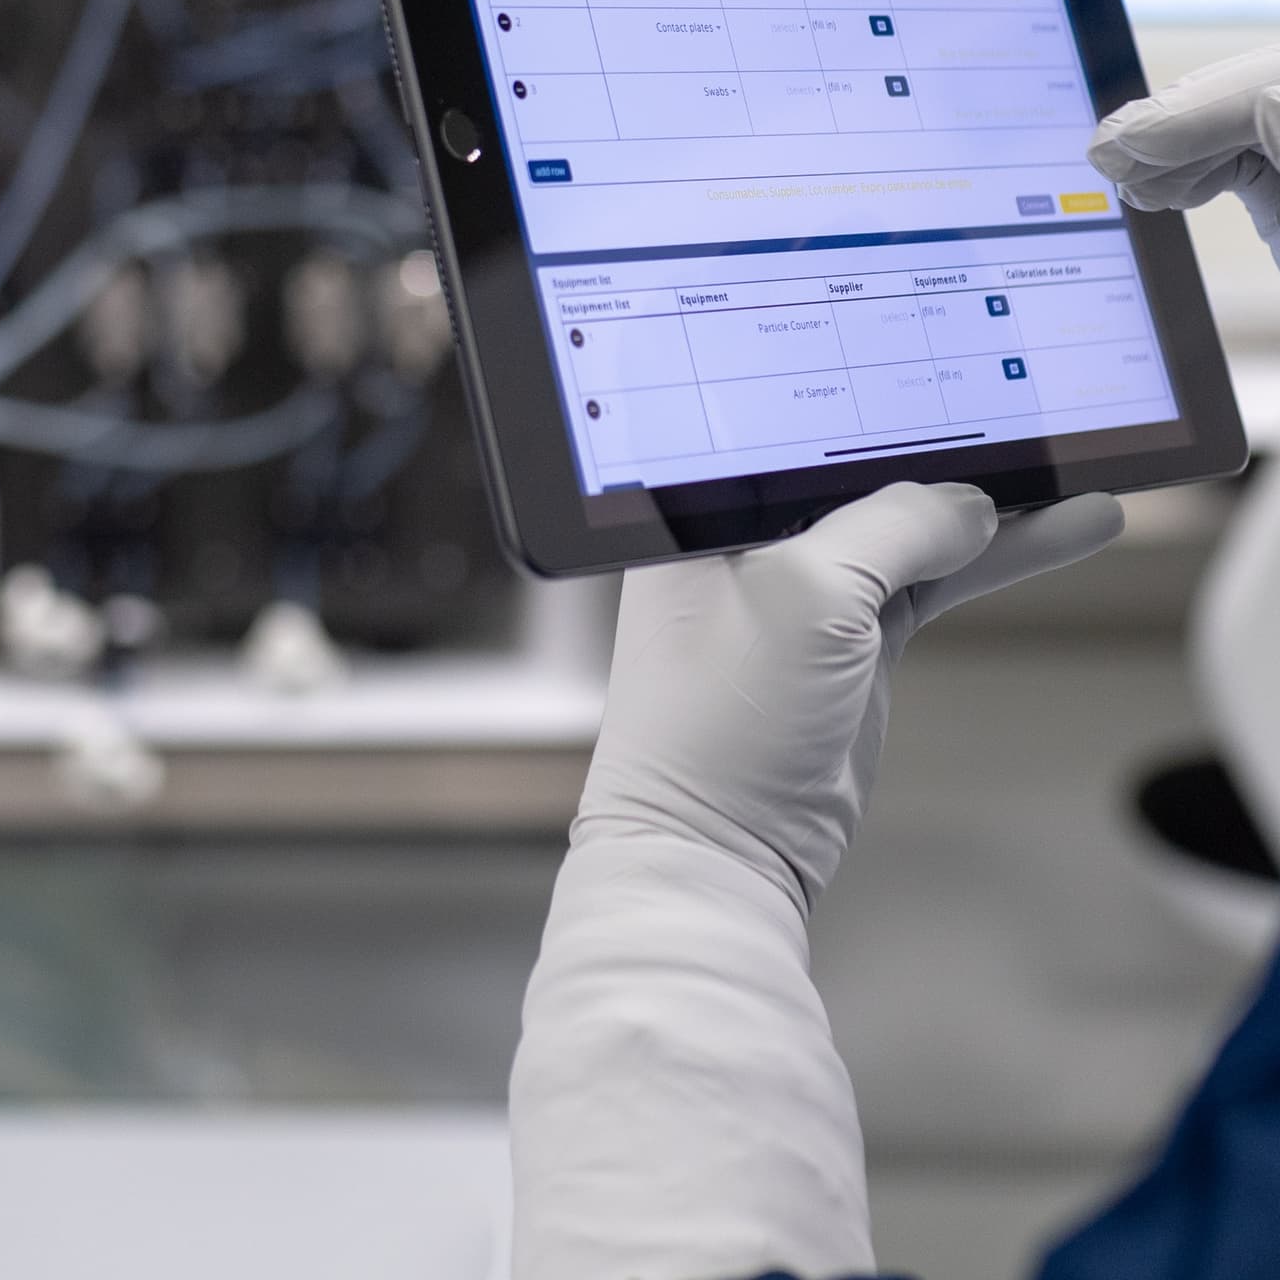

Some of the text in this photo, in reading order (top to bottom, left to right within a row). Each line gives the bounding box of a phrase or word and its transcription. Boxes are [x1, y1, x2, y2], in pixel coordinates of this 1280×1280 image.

[656, 22, 714, 35] Contact plates
[704, 86, 729, 97] Swabs
[1006, 266, 1081, 280] Calibration due date
[552, 275, 612, 289] Equipment list
[914, 273, 967, 288] Equipment ID
[829, 282, 864, 294] Supplier
[680, 292, 729, 306] Equipment
[562, 300, 631, 315] Equipment list
[758, 319, 821, 334] Particle Counter
[793, 385, 838, 399] Air Sampler
